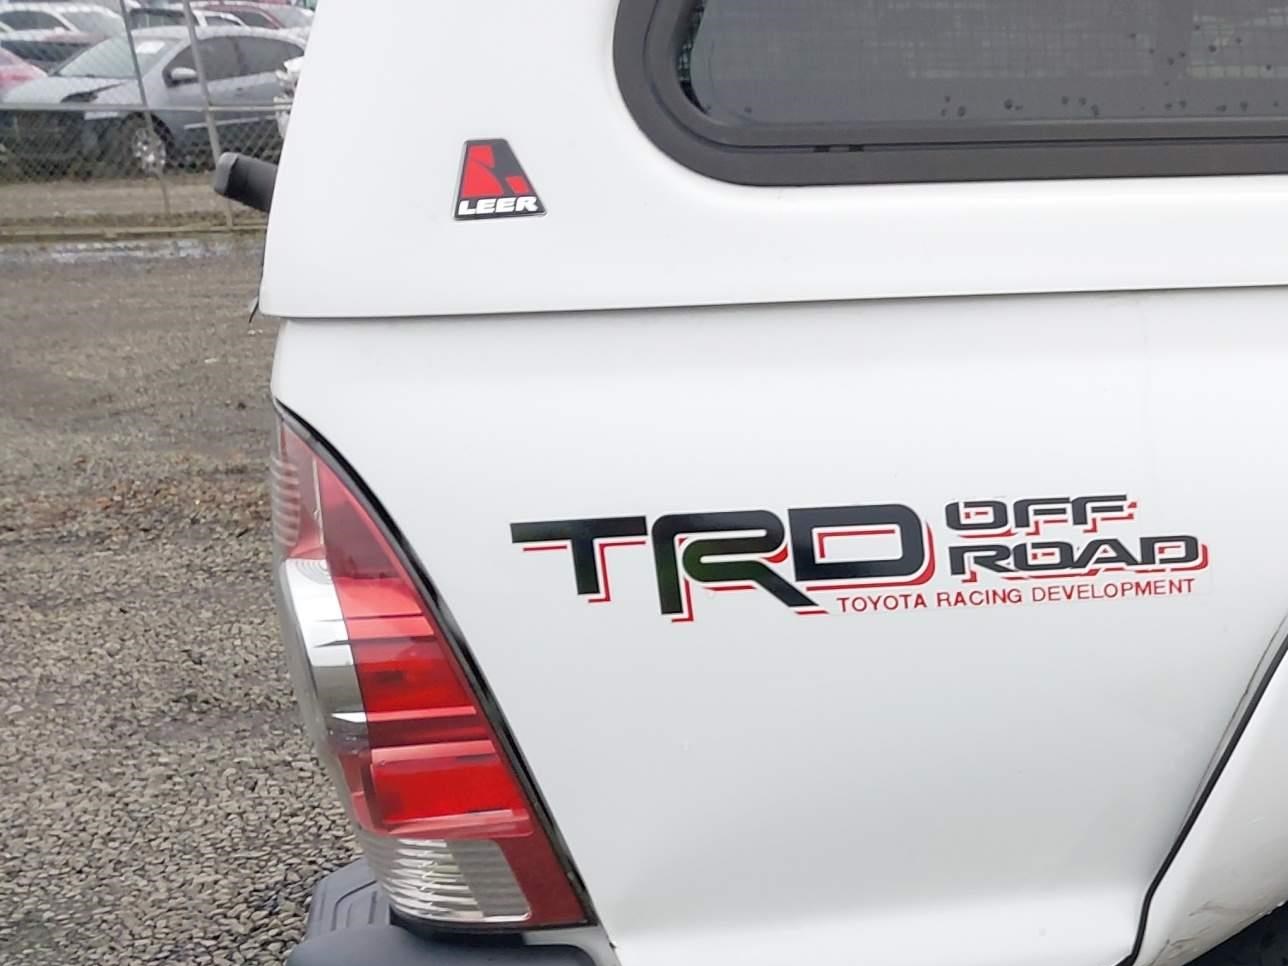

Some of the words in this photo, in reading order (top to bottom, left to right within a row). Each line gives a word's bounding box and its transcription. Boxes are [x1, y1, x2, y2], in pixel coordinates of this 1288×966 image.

[457, 196, 540, 216] LEER
[945, 494, 1137, 538] OFF
[510, 502, 935, 622] TRD
[948, 534, 1208, 583] ROAD
[837, 592, 929, 614] TOYOTA
[936, 586, 1023, 609] RACING
[1031, 578, 1196, 604] DEVELOPMENT
